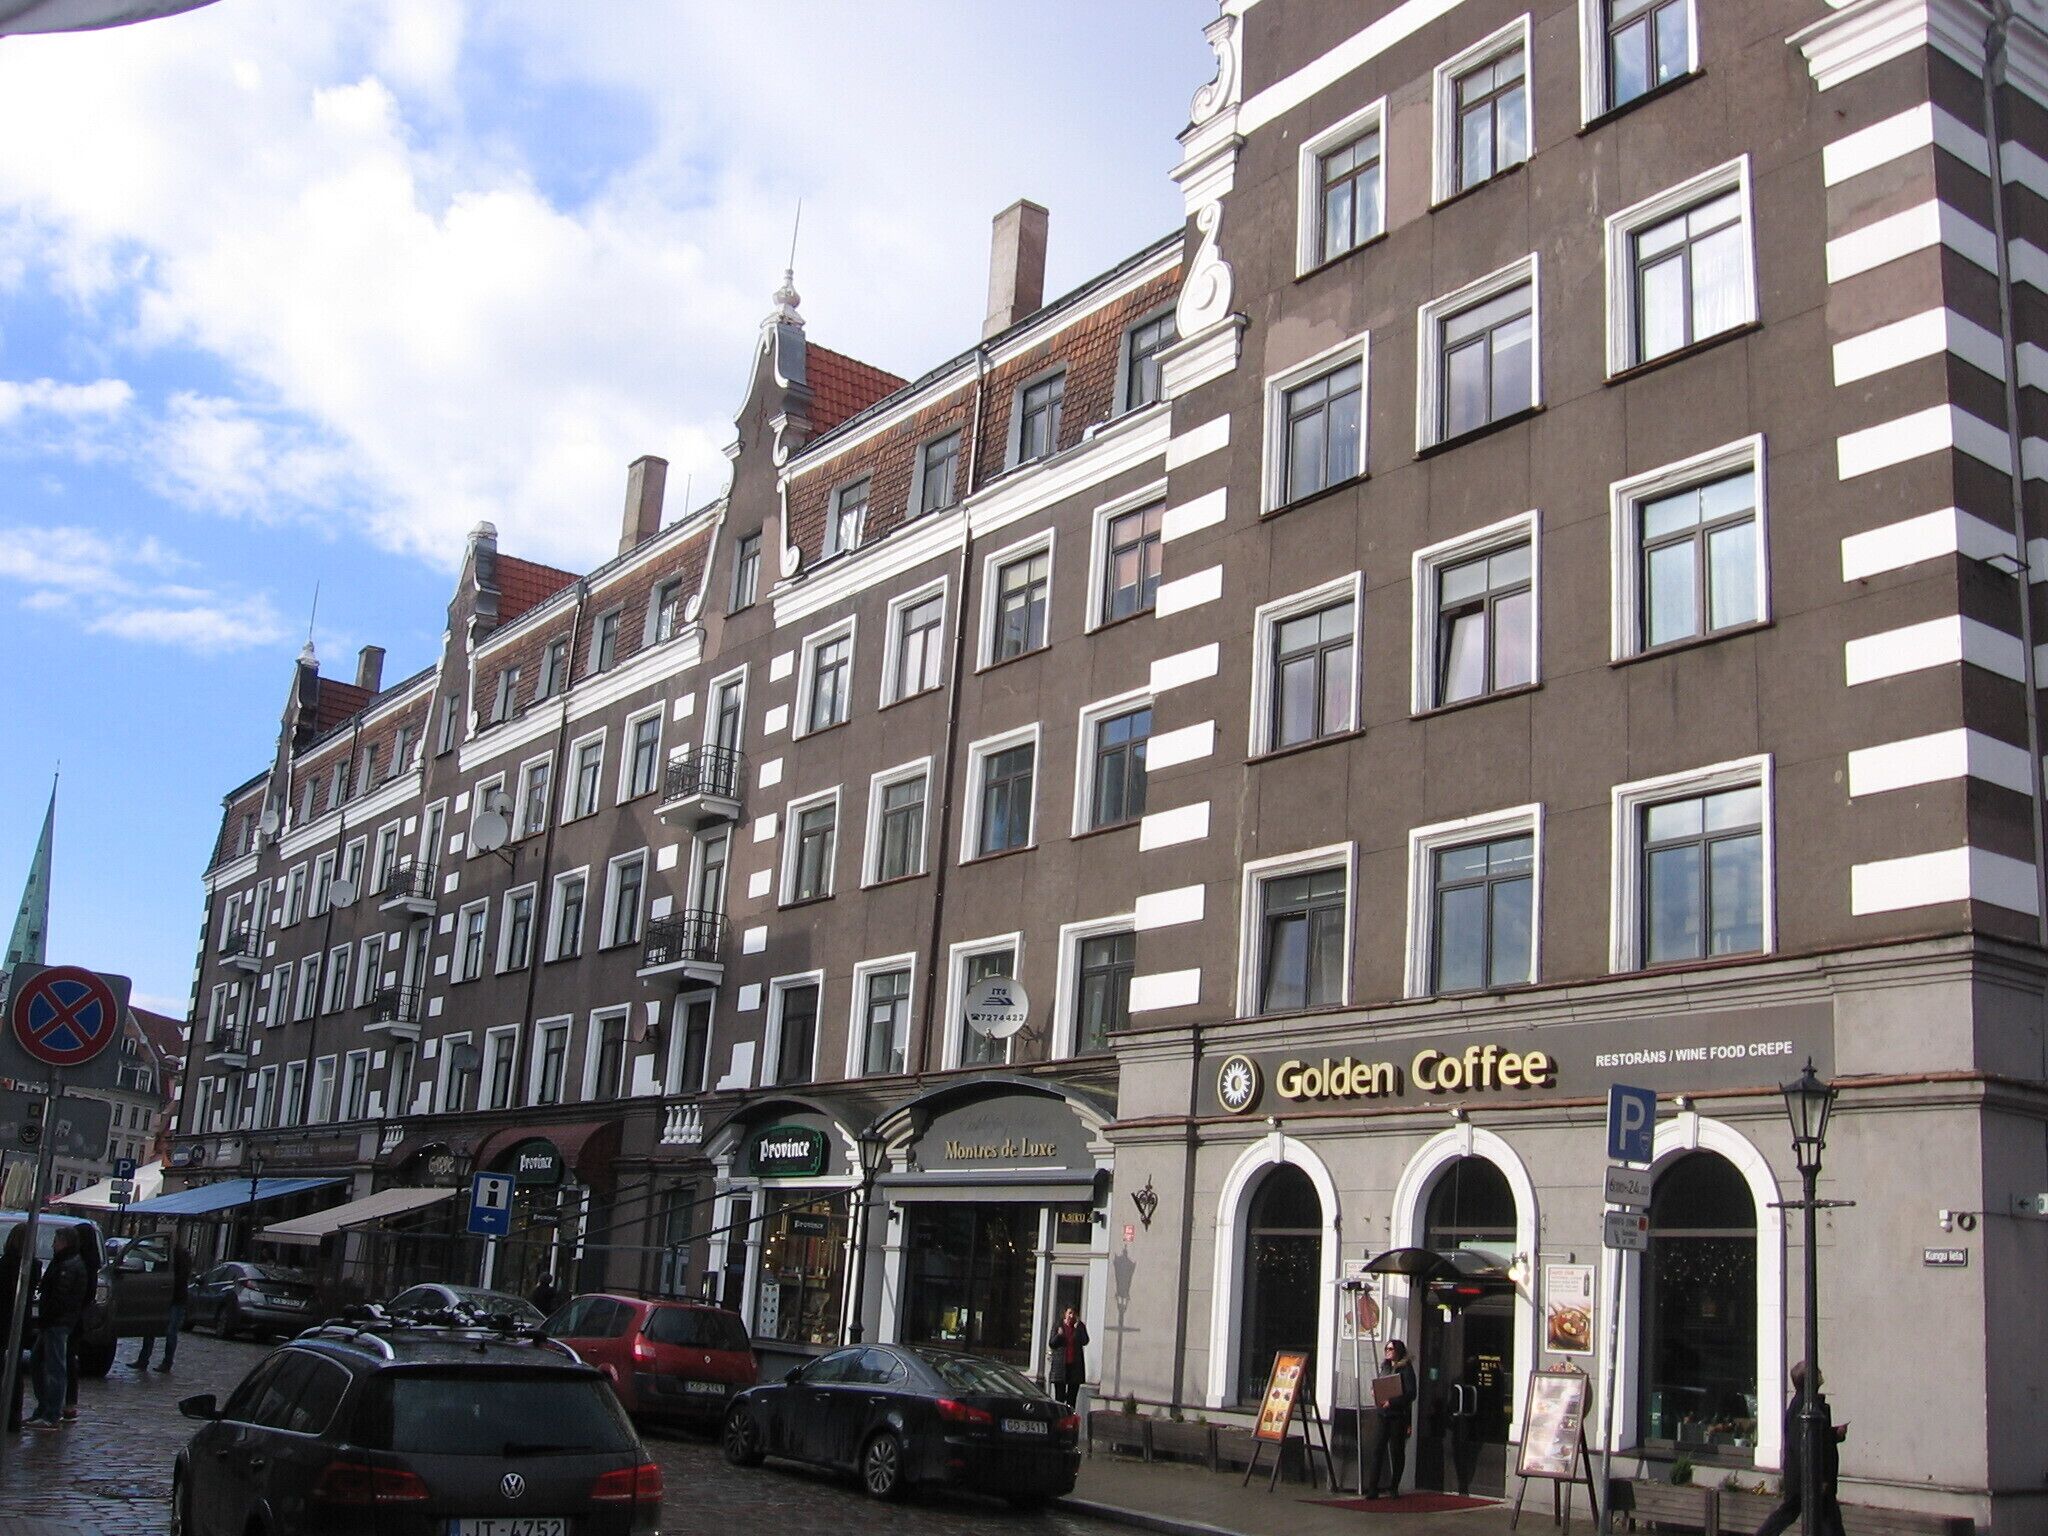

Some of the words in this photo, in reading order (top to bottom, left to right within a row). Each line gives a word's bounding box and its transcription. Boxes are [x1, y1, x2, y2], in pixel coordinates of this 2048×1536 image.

[1676, 1047, 1707, 1061] WINE
[1710, 1044, 1746, 1059] FOOD
[1748, 1040, 1793, 1057] CREPE
[1276, 1056, 1394, 1098] Golden
[1411, 1045, 1547, 1090] Coffee
[1619, 1094, 1646, 1150] P
[760, 1138, 811, 1162] Province
[945, 1140, 998, 1160] Montres
[1001, 1139, 1018, 1158] de
[1021, 1137, 1057, 1157] Luxe
